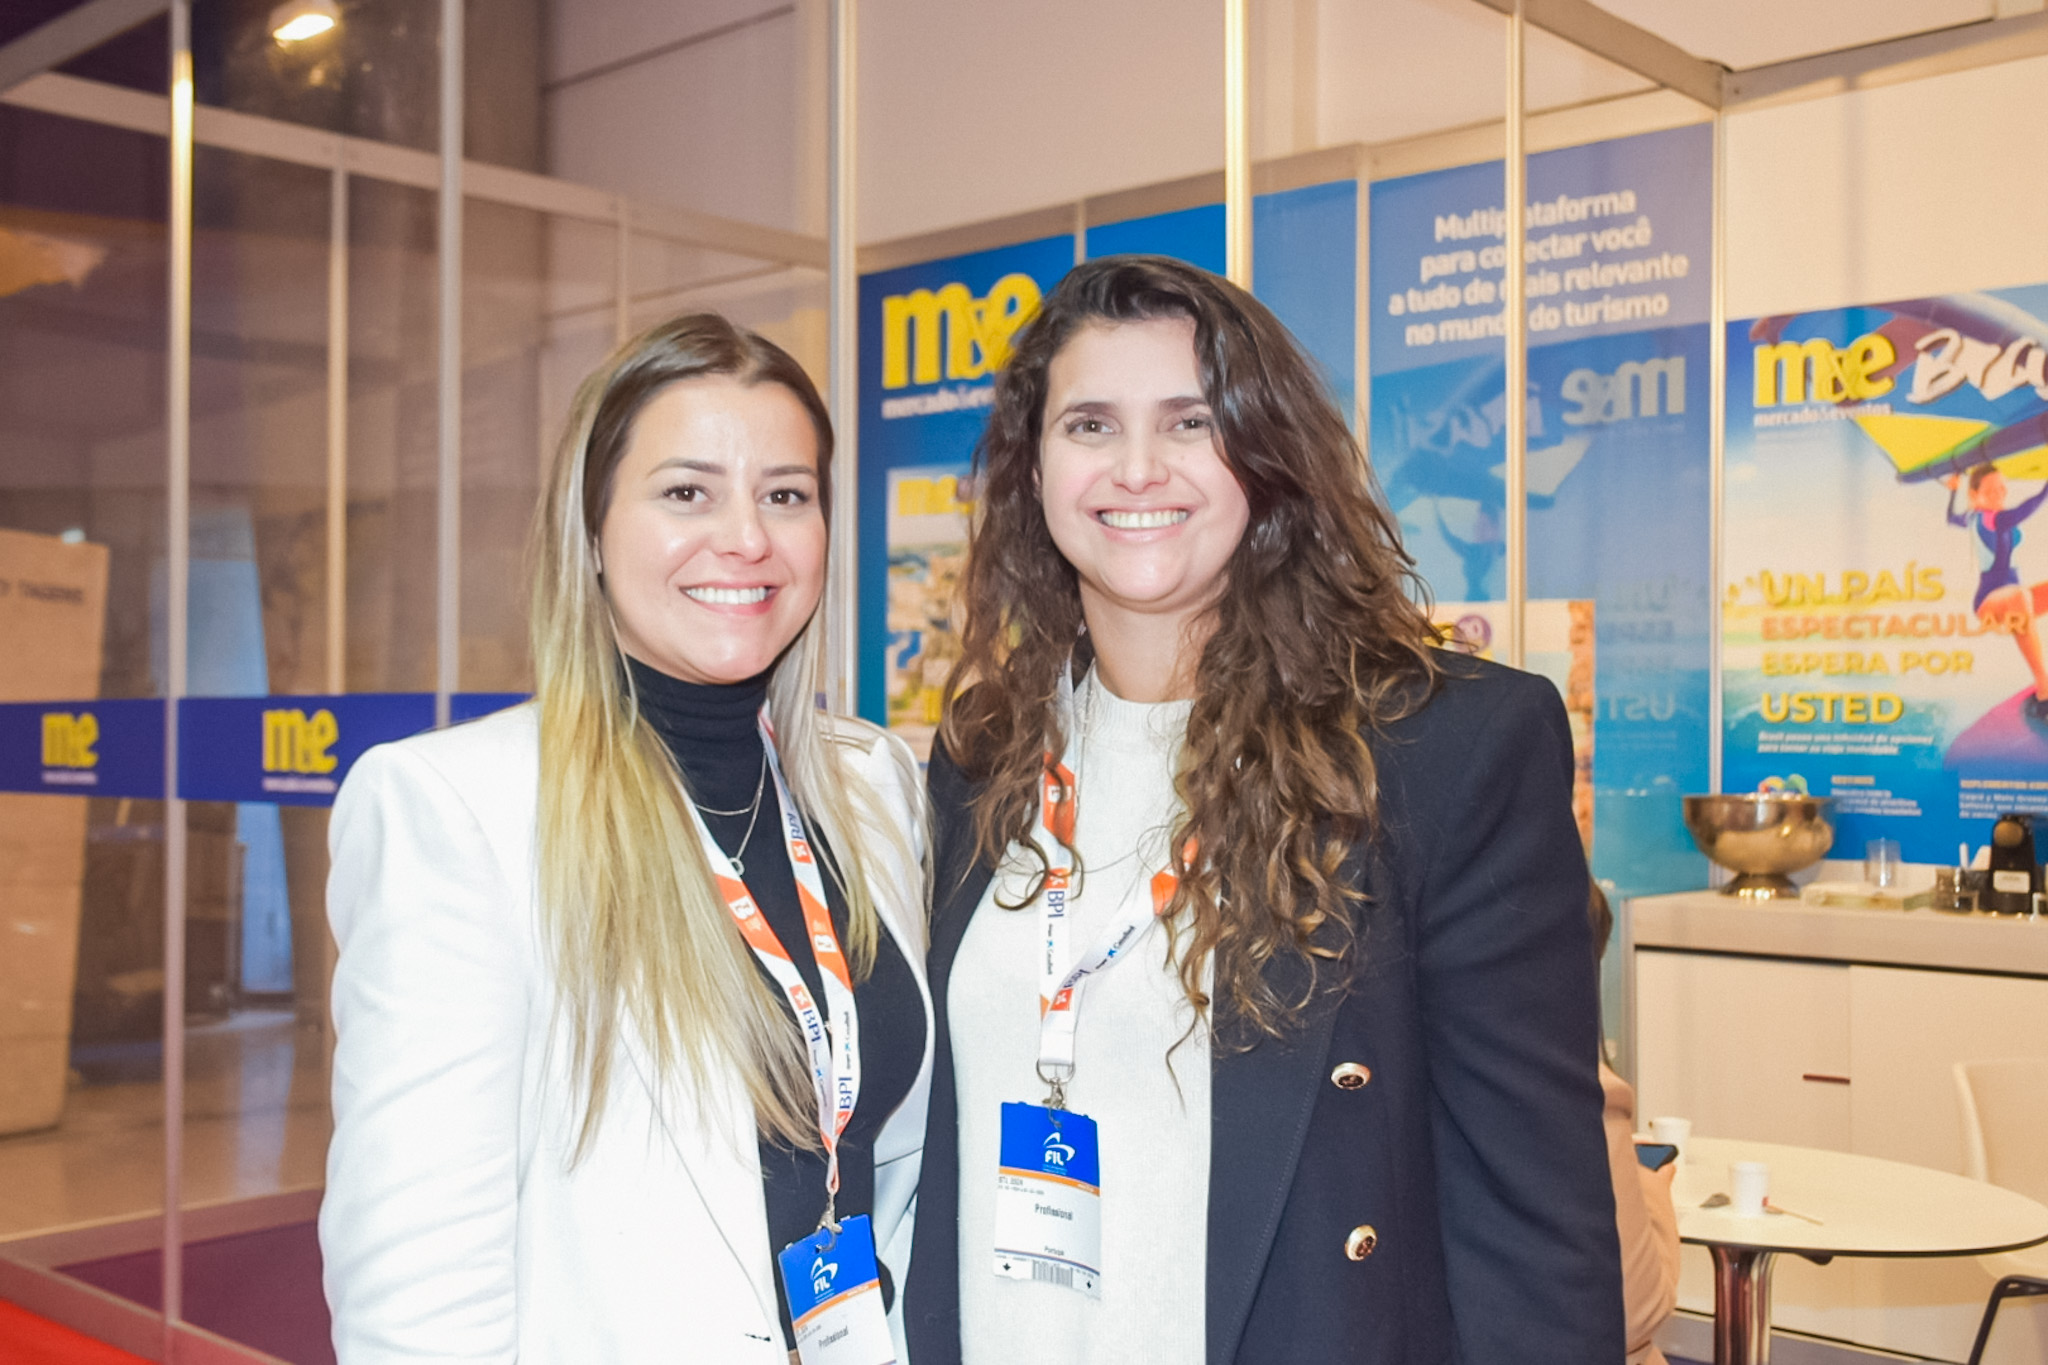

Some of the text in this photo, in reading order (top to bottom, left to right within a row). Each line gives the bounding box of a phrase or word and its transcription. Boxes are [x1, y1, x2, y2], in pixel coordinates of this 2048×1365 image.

[1434, 189, 1637, 242] Multipataforma
[1420, 215, 1652, 283] para coectar você
[1388, 293, 1406, 316] a
[1407, 283, 1461, 313] tudo
[1464, 277, 1496, 306] de
[1564, 252, 1690, 292] relevante
[1405, 293, 1670, 347] no mund do turismo
[1753, 327, 2048, 408] m&e Bra
[1761, 560, 1945, 607] UN PAÍS
[1761, 610, 2028, 642] ESPECTACULAR
[1761, 650, 1974, 676] ESPERA POR
[1761, 692, 1904, 725] USTED
[1047, 890, 1065, 918] BPI
[803, 1009, 821, 1042] BPI
[838, 1076, 853, 1109] BPI
